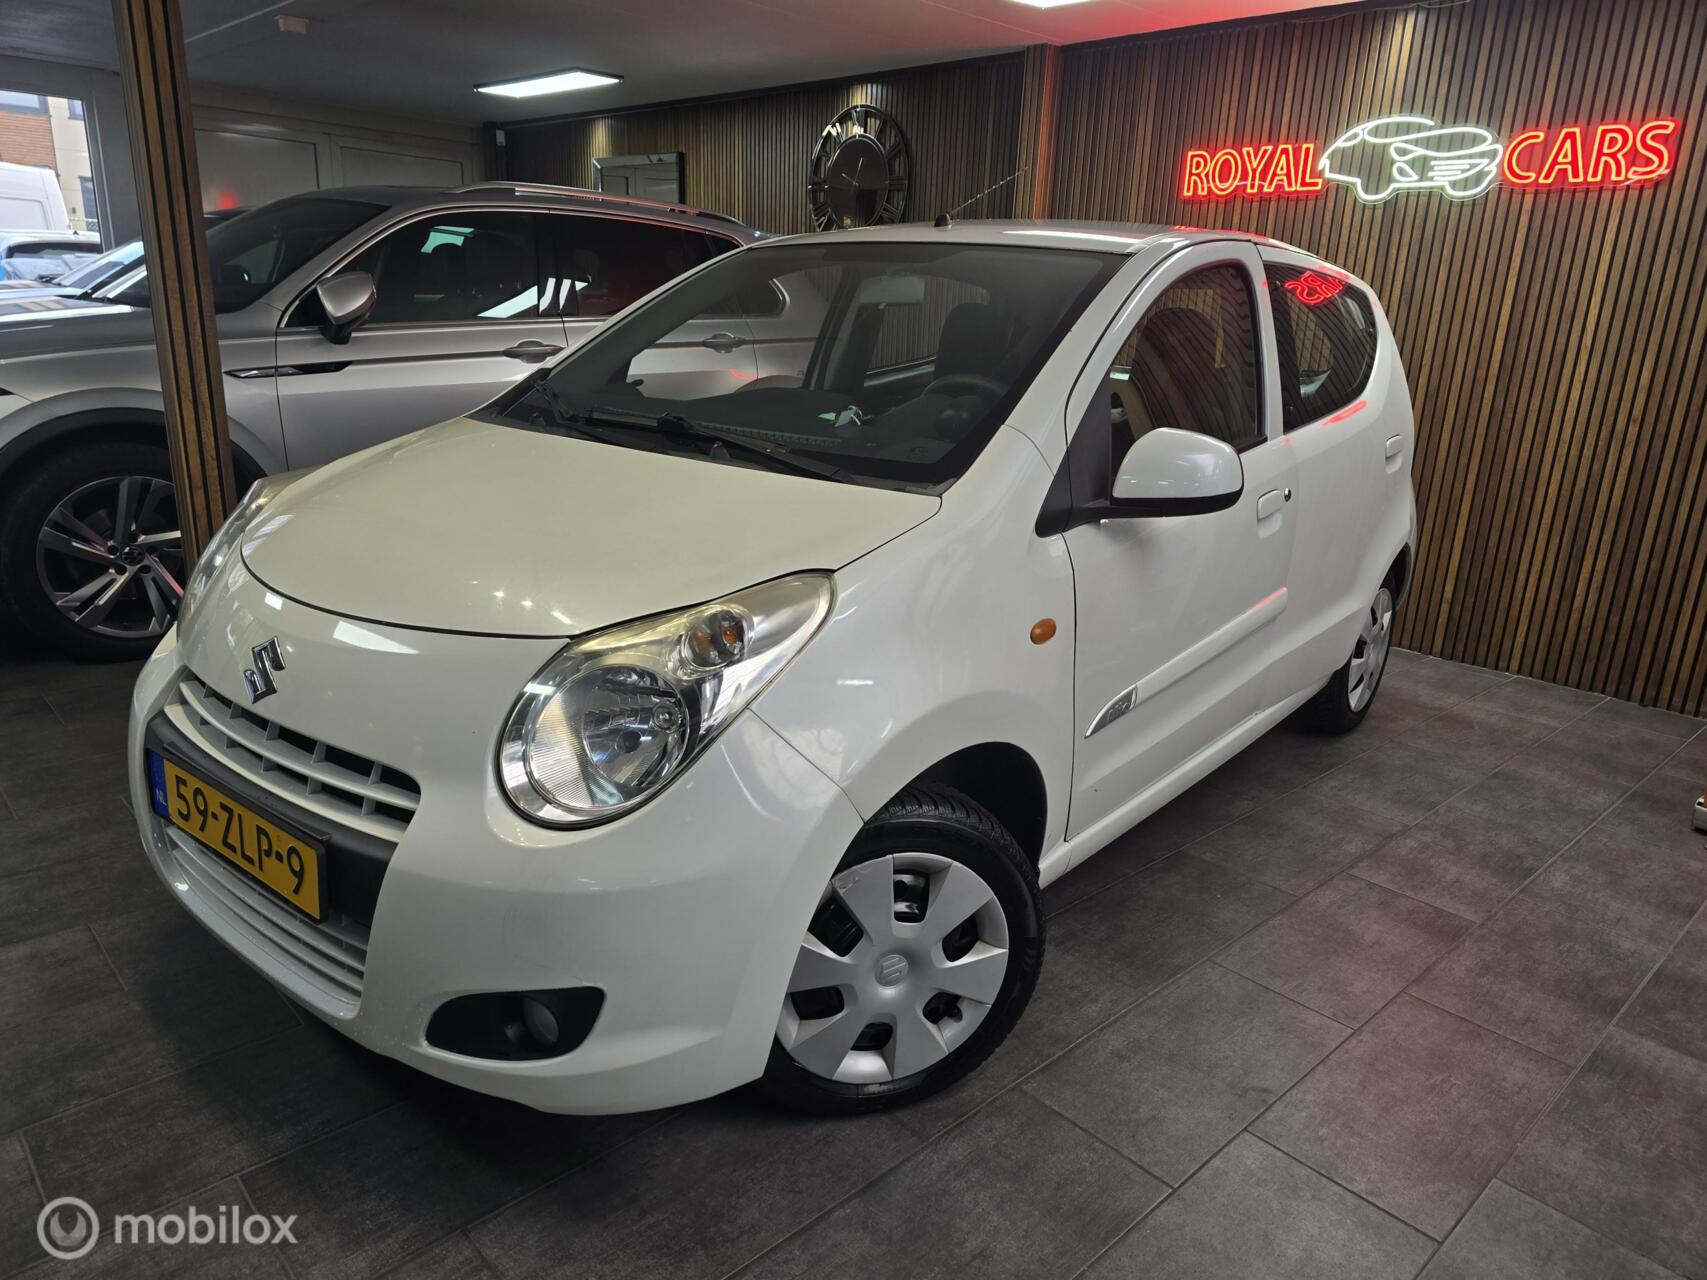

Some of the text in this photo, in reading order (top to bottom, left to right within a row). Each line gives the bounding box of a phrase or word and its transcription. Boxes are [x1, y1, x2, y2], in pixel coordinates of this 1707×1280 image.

[1182, 119, 1677, 197] ROYAL CARS
[155, 788, 168, 807] NL
[175, 774, 305, 896] 59-ZLP-9
